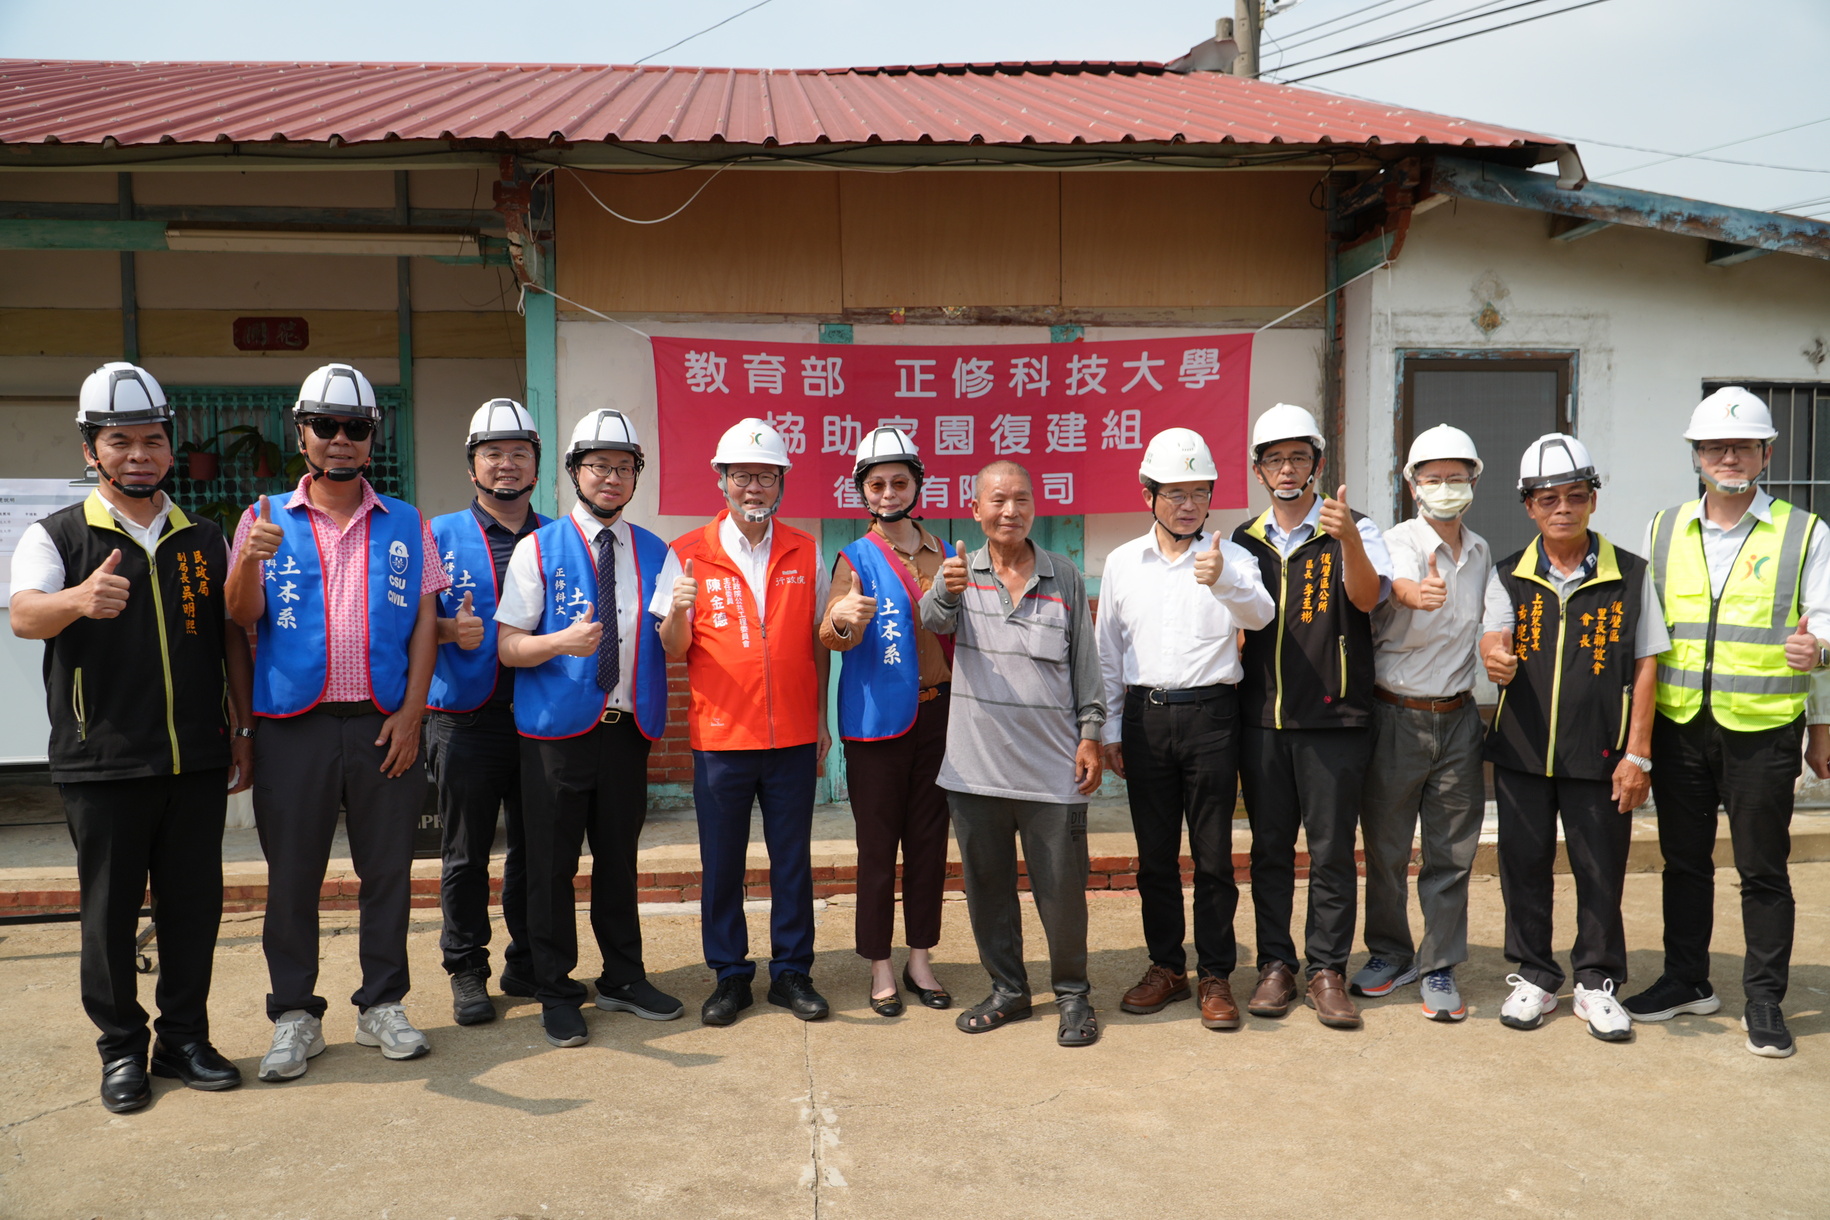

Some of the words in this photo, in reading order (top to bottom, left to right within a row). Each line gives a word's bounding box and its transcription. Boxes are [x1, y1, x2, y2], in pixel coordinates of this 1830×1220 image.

[684, 350, 845, 398] 教育部
[895, 348, 1220, 398] 正修科技大學
[192, 550, 211, 597] 民政局
[265, 551, 278, 582] 科大
[389, 574, 406, 590] CSU
[277, 556, 301, 629] 土木系
[388, 590, 408, 607] CIVIL
[554, 567, 566, 615] 正修科大
[705, 578, 728, 629] 陳金德
[723, 577, 734, 605] 主任委員
[731, 576, 750, 648] 行政院公共工程委員會
[880, 597, 902, 666] 土木系
[1579, 612, 1594, 648] 會長
